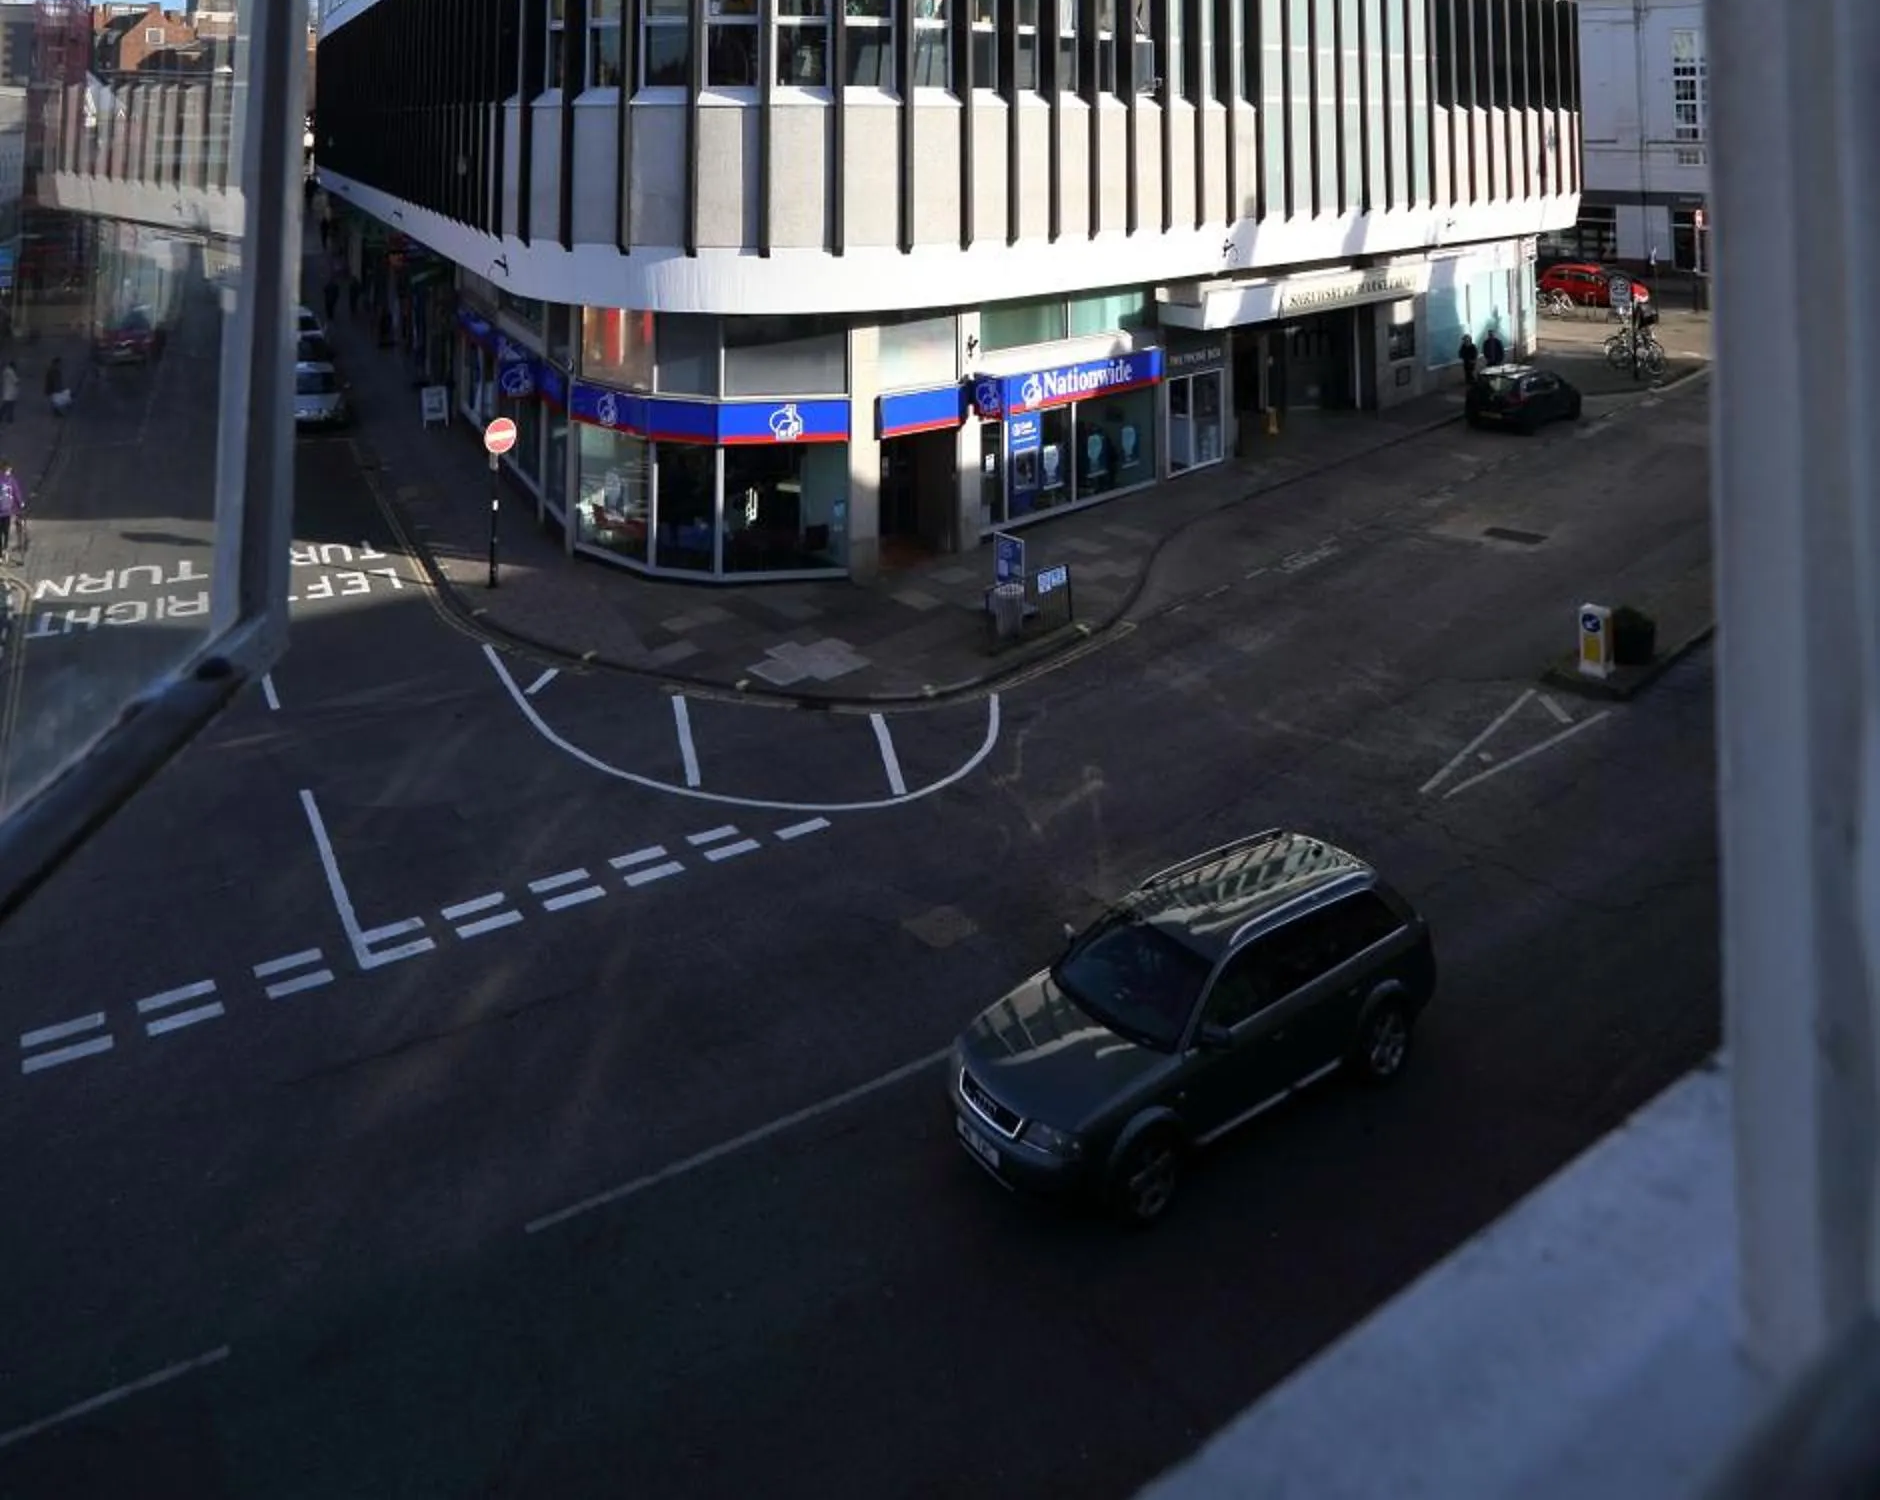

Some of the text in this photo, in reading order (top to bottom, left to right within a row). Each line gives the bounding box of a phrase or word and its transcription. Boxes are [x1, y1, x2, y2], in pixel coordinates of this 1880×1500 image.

[1043, 359, 1133, 398] Nationwide
[290, 540, 386, 566] TUR
[34, 561, 209, 600] TURN
[287, 568, 403, 602] LEF
[25, 592, 210, 639] RIGHT
